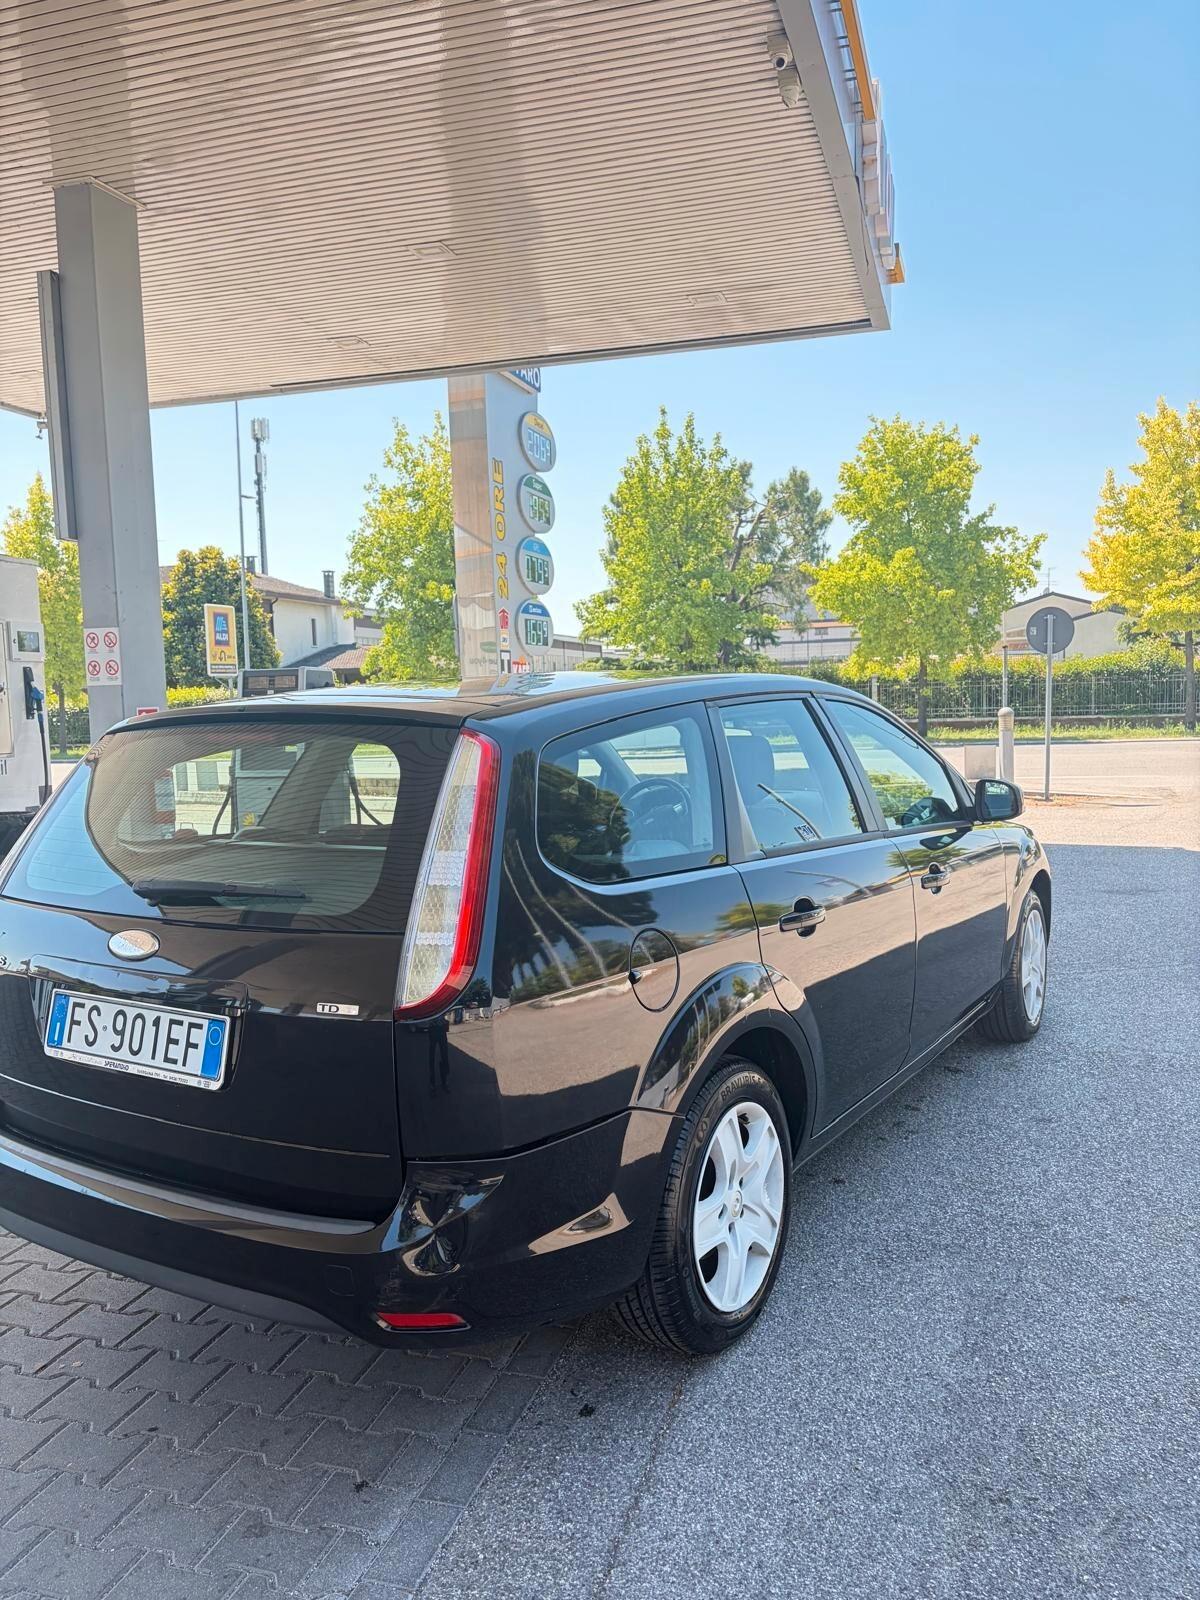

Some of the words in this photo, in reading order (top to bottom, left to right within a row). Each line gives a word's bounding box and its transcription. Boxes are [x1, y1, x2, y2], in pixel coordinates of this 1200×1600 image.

[492, 457, 506, 542] ORE
[495, 551, 509, 600] 24
[215, 632, 229, 641] ALDI
[527, 620, 548, 645] 1699
